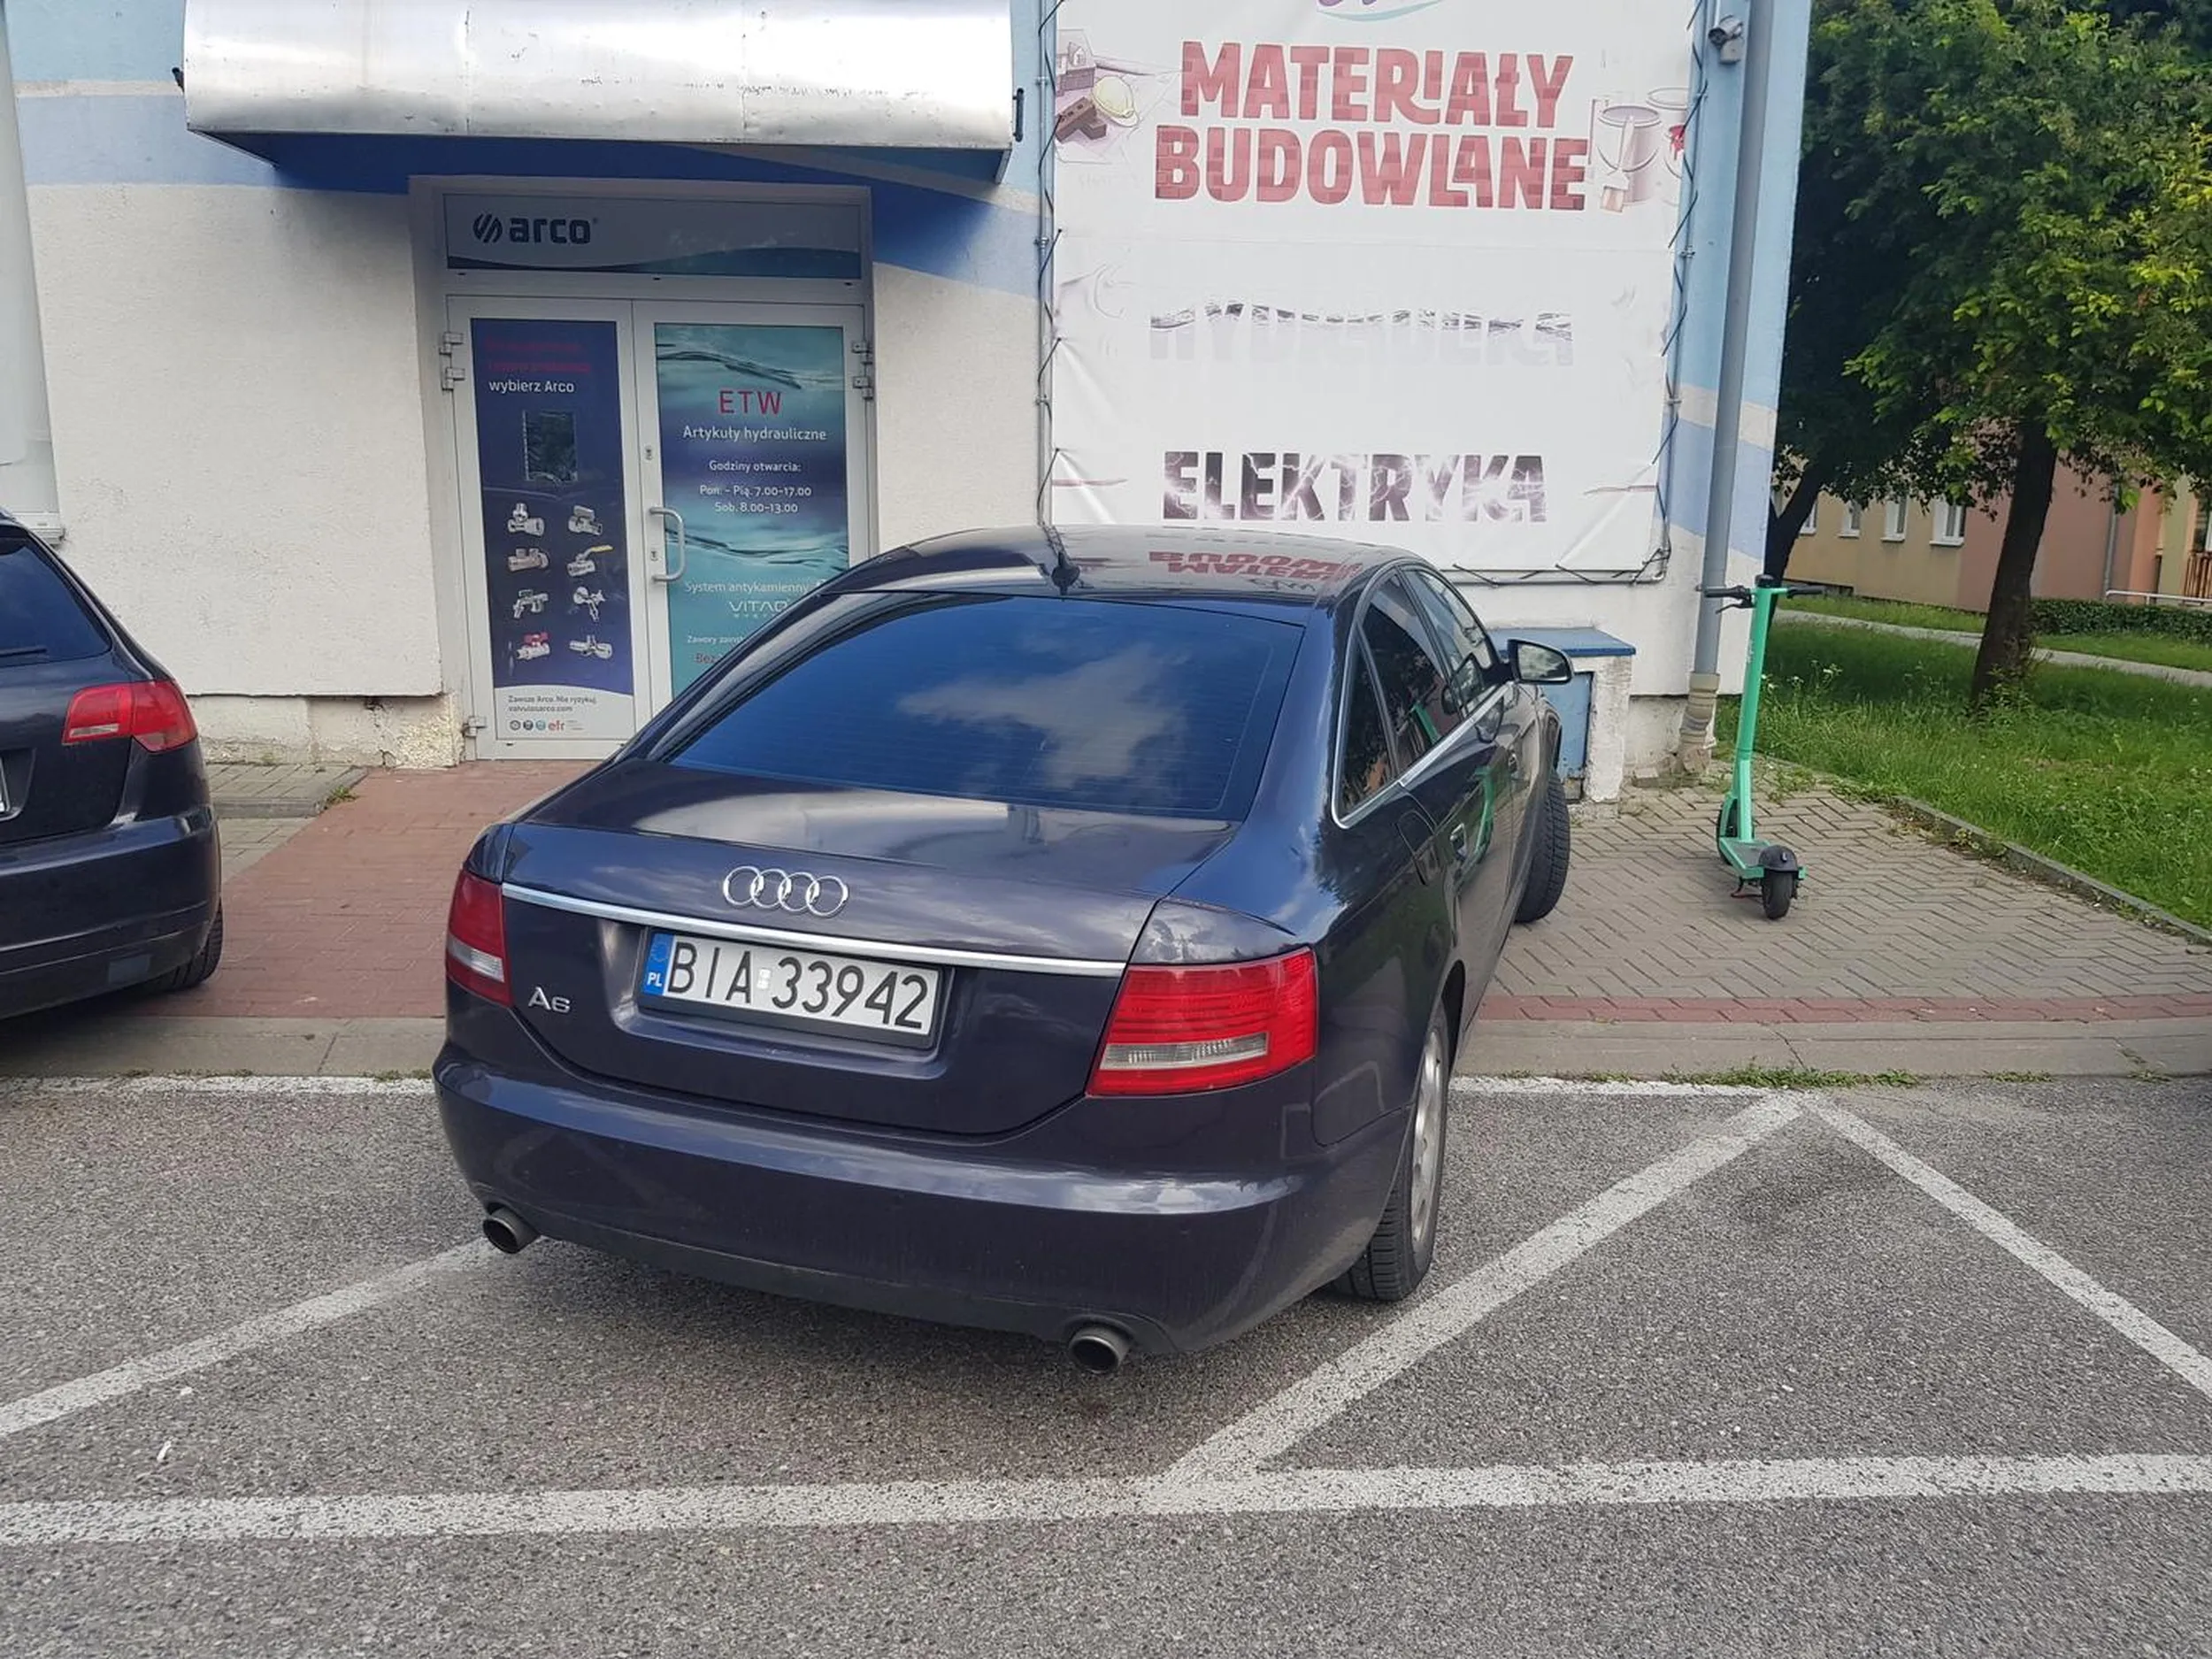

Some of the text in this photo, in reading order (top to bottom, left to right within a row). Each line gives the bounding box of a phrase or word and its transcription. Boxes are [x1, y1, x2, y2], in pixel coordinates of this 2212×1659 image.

[1180, 41, 1574, 128] MATERIAŁY
[1154, 124, 1589, 211] BUDOWLANE
[509, 218, 591, 244] arco
[488, 379, 575, 394] wybierz Arco
[718, 390, 782, 415] ETW
[682, 425, 826, 442] Artykuły hydrauliczne
[709, 459, 802, 473] Godziny otwarcia:
[1164, 450, 1548, 522] ELEKTRYKA
[714, 501, 738, 512] Sob.
[684, 581, 726, 594] System
[647, 941, 928, 1030] PL BIA 33942
[527, 986, 572, 1013] A6
